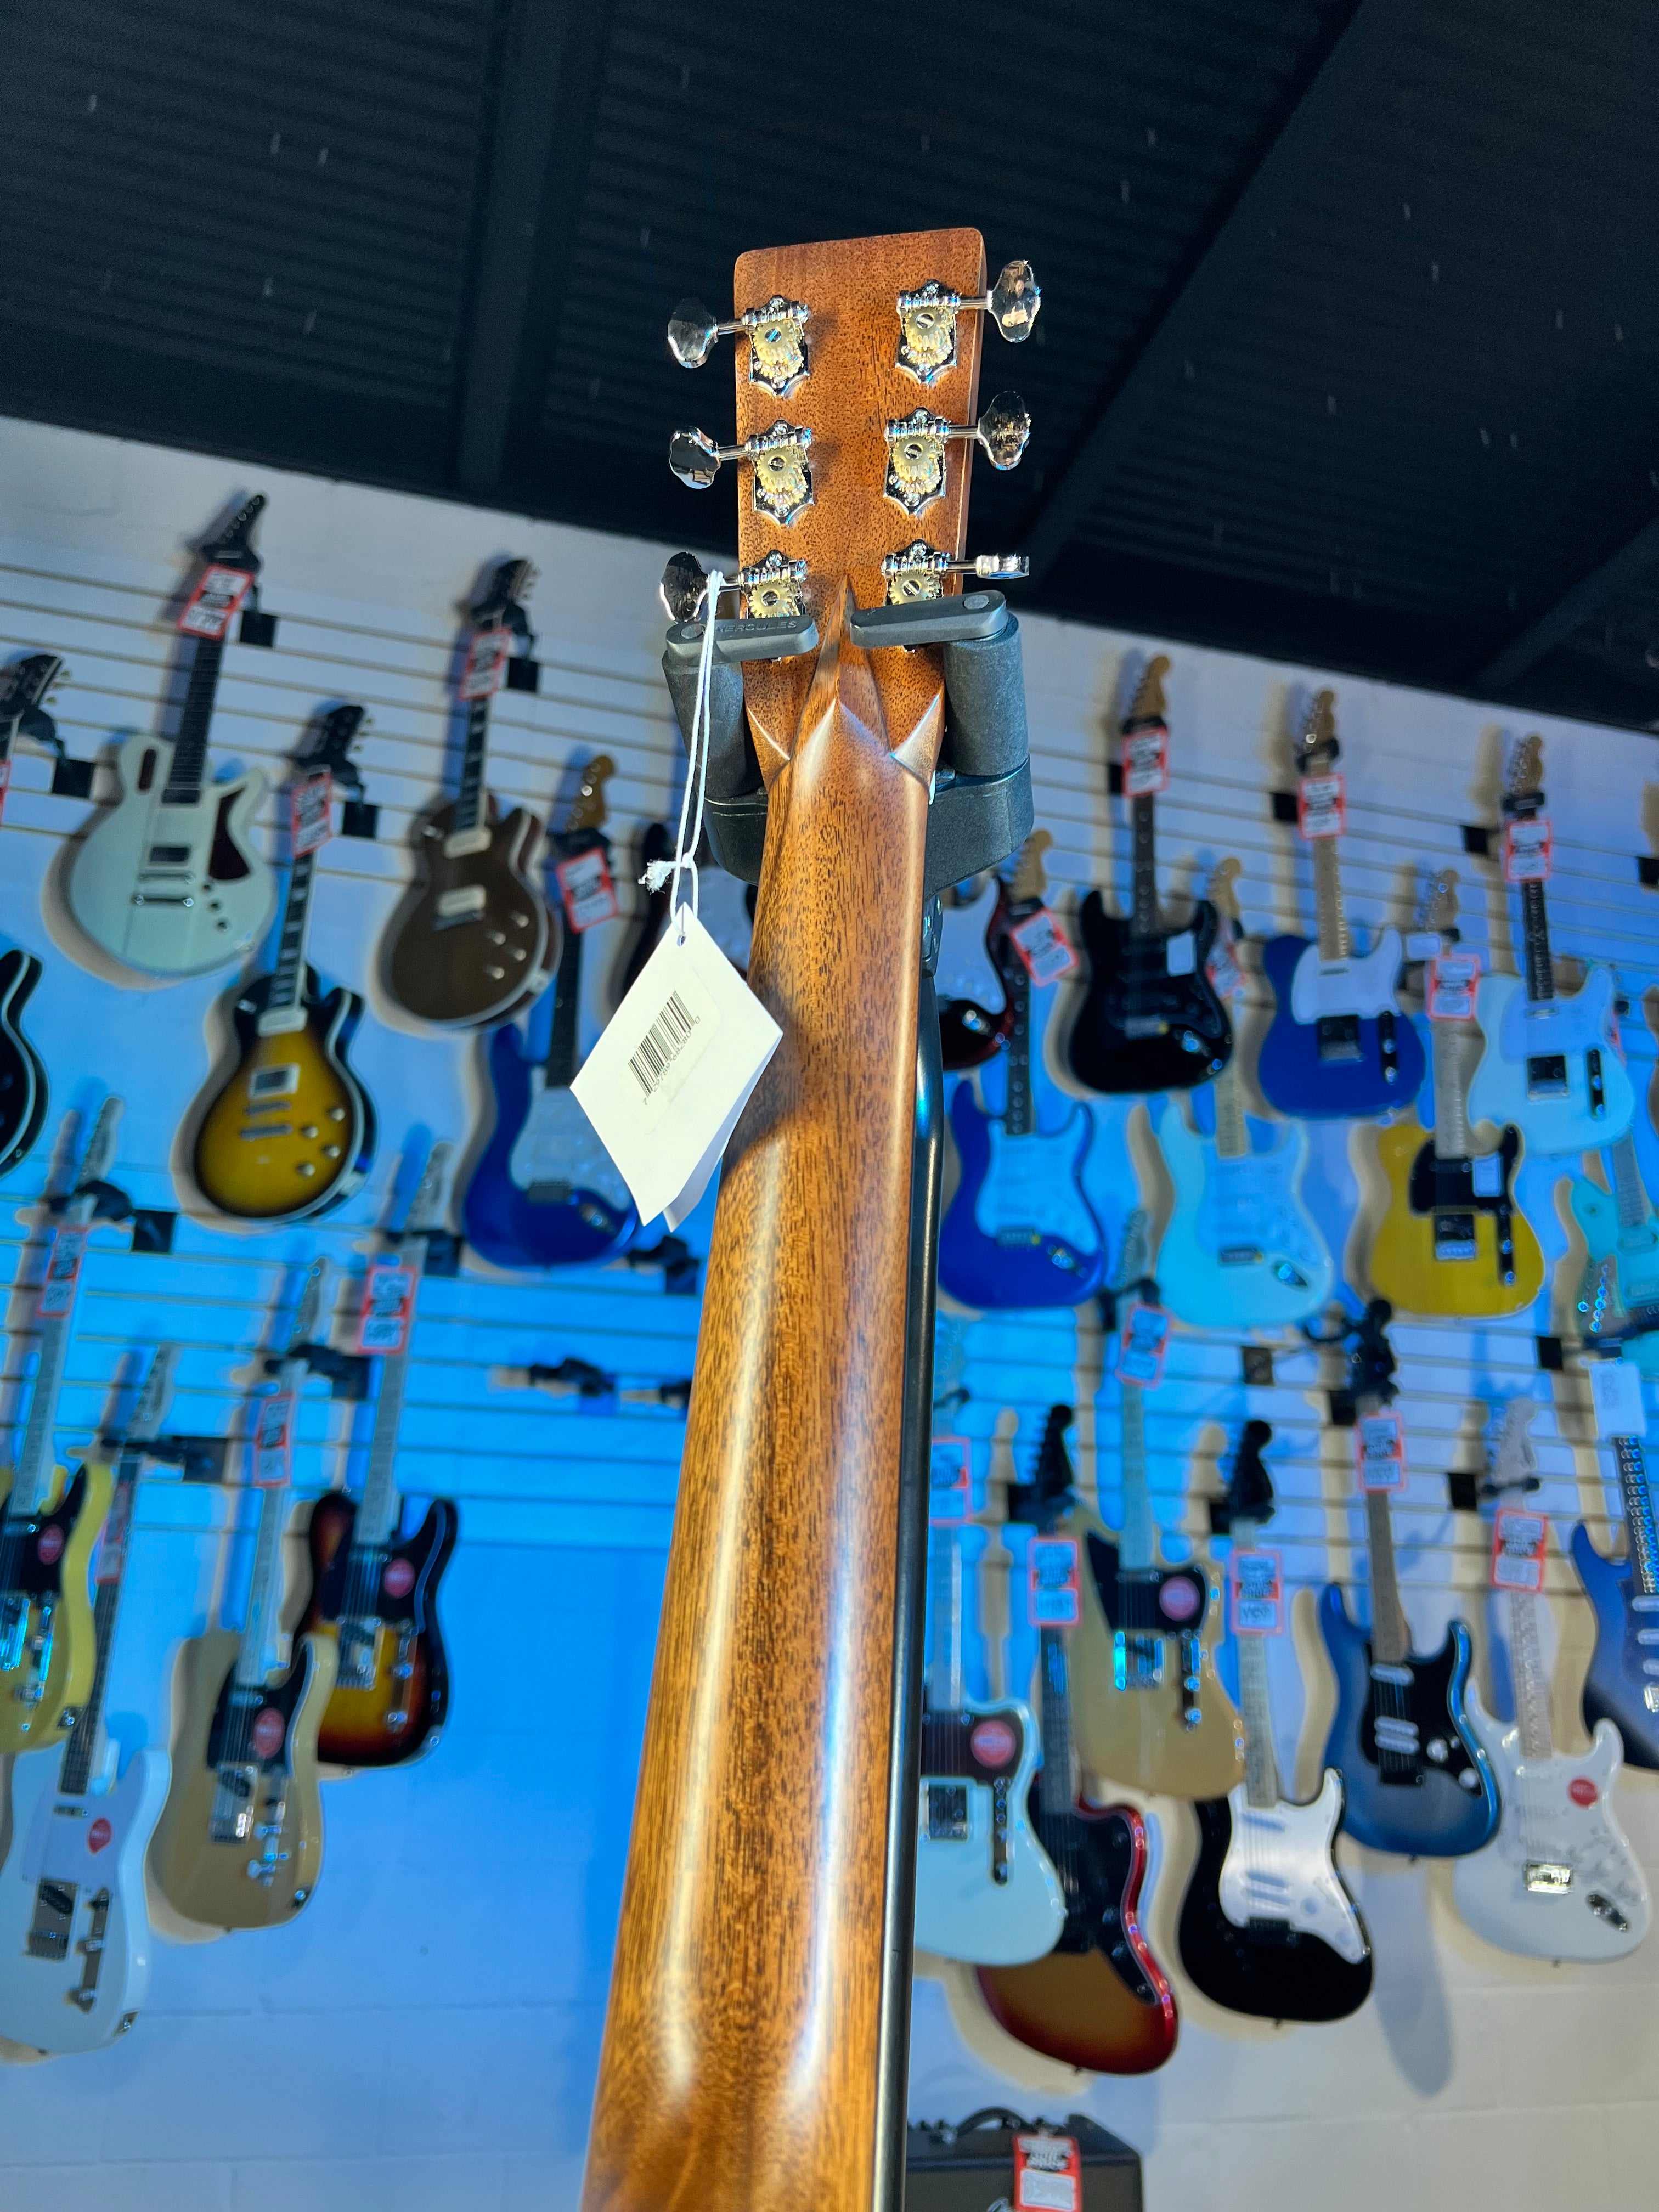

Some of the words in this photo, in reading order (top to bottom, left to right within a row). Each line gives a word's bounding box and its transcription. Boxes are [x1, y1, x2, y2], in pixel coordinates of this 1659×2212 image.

[642, 1097, 647, 1105] 7
[653, 1062, 670, 1092] 29789
[673, 1030, 692, 1061] 68280
[695, 1015, 701, 1024] 0
